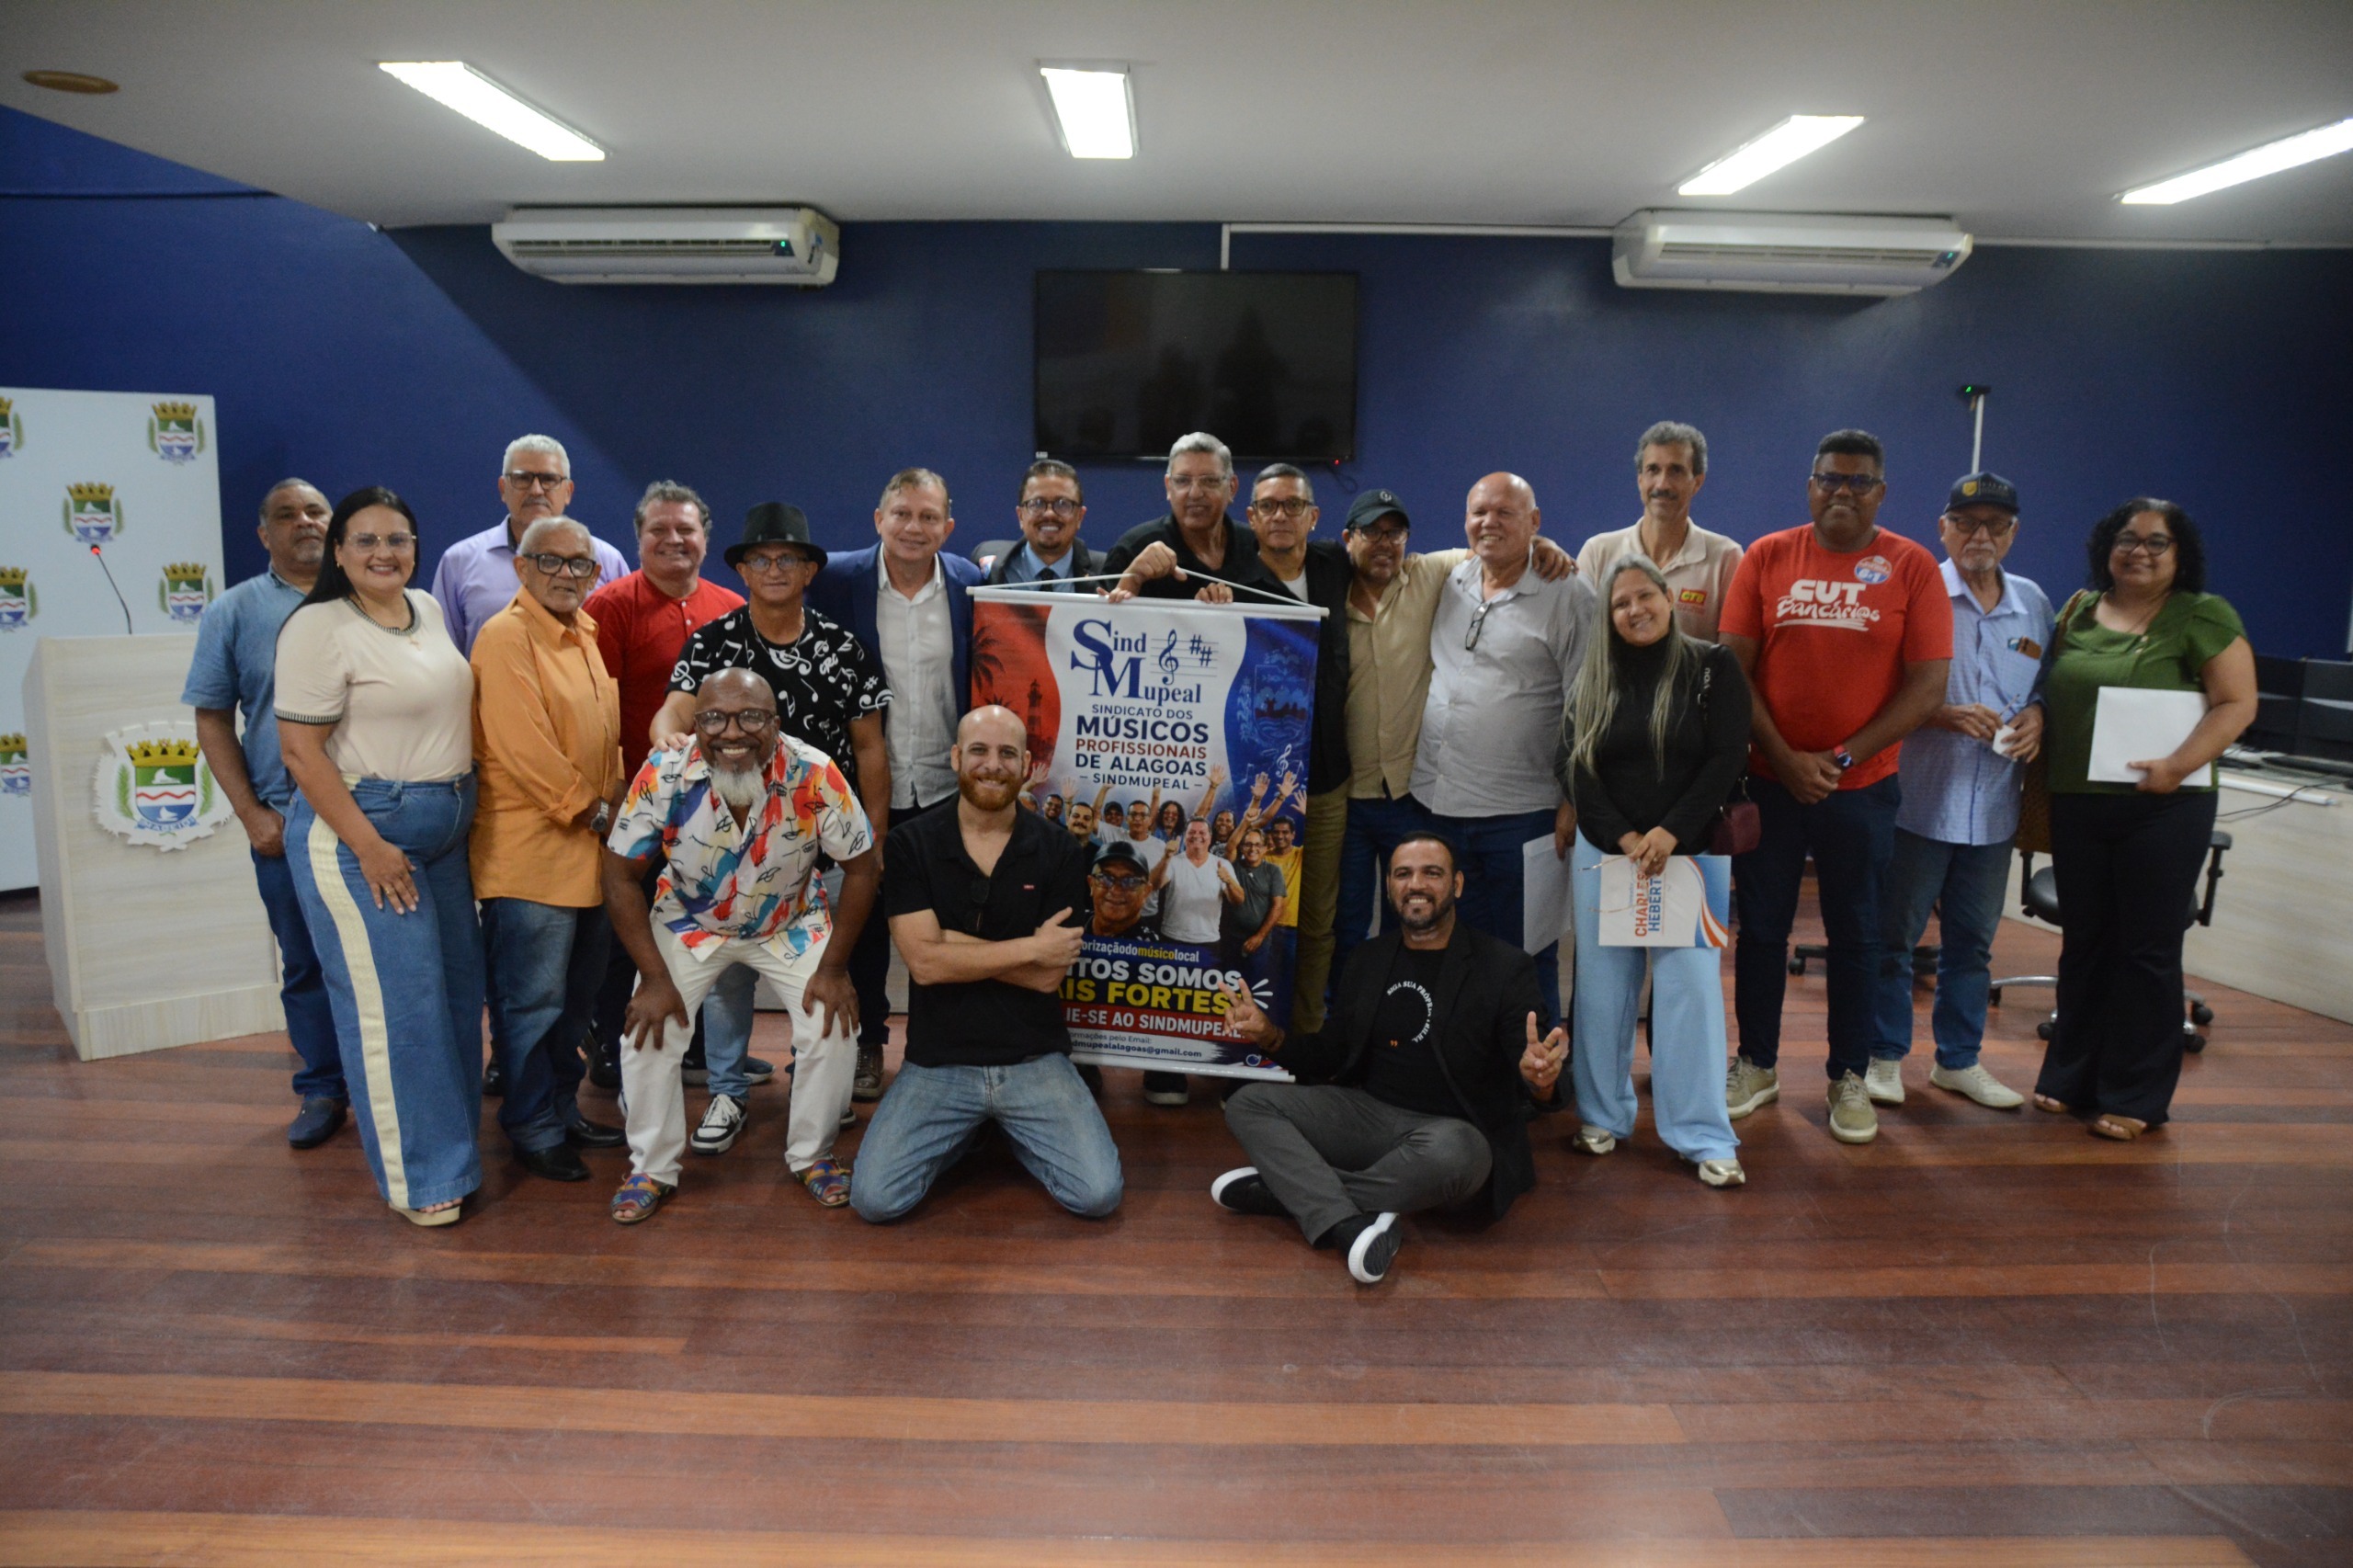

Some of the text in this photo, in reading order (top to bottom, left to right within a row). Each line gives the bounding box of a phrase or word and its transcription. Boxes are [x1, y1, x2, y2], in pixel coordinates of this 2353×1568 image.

[1790, 579, 1867, 606] CUT
[1071, 619, 1147, 670] Sind
[1088, 656, 1201, 707] Mupeal
[1092, 704, 1193, 720] SINDICATO DOS
[1076, 715, 1209, 744] MÚSICOS
[1075, 738, 1207, 759] PROFISSIONAIS
[1075, 753, 1206, 777] DE ALAGOAS
[1093, 773, 1190, 790] SINDMUPEAL
[1648, 878, 1662, 932] HEBERT
[1138, 962, 1242, 992] SOMOS
[1403, 981, 1416, 989] SUA
[1112, 1012, 1134, 1027] AO
[1109, 1033, 1126, 1042] pelo
